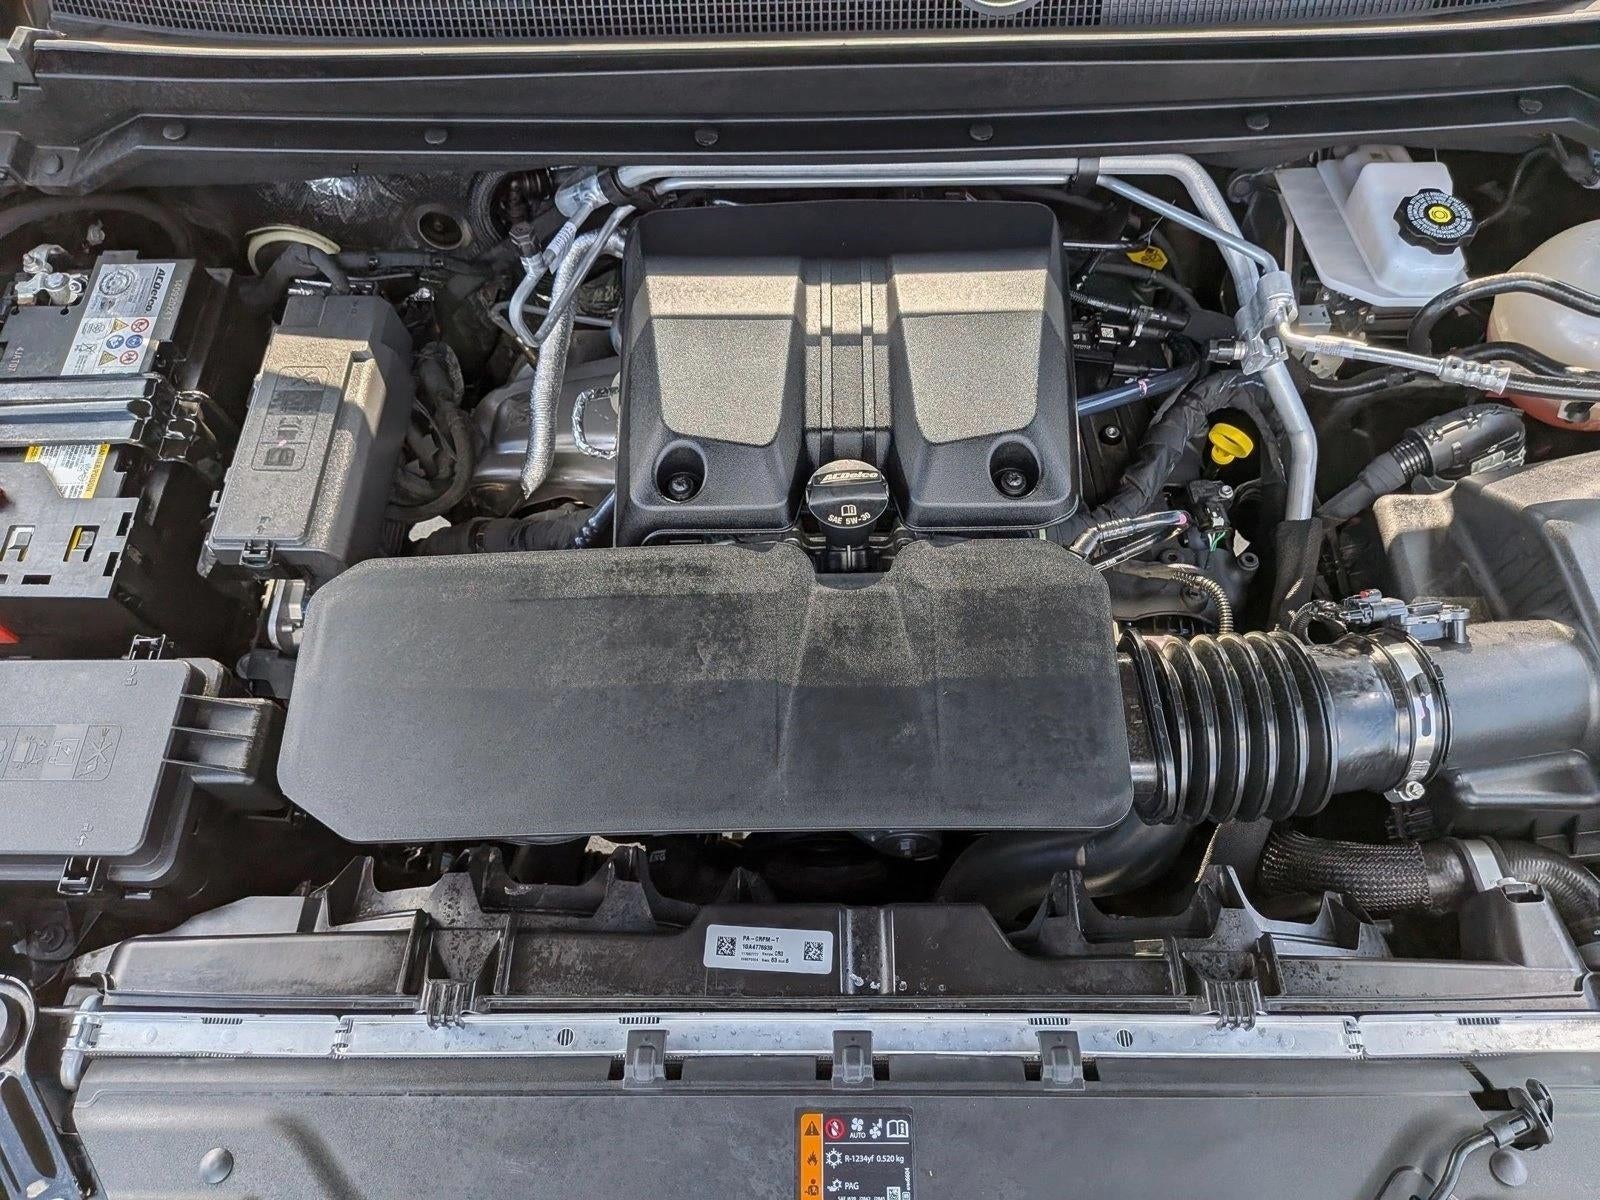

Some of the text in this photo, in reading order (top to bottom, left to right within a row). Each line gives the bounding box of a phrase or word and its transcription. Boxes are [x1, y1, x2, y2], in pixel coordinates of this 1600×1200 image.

[145, 268, 165, 312] ACDelco
[820, 472, 878, 484] ACDelco
[827, 511, 871, 525] SAE 5W-30
[844, 1155, 905, 1164] R-1234yf 0.520 kg
[844, 1181, 860, 1191] PAG
